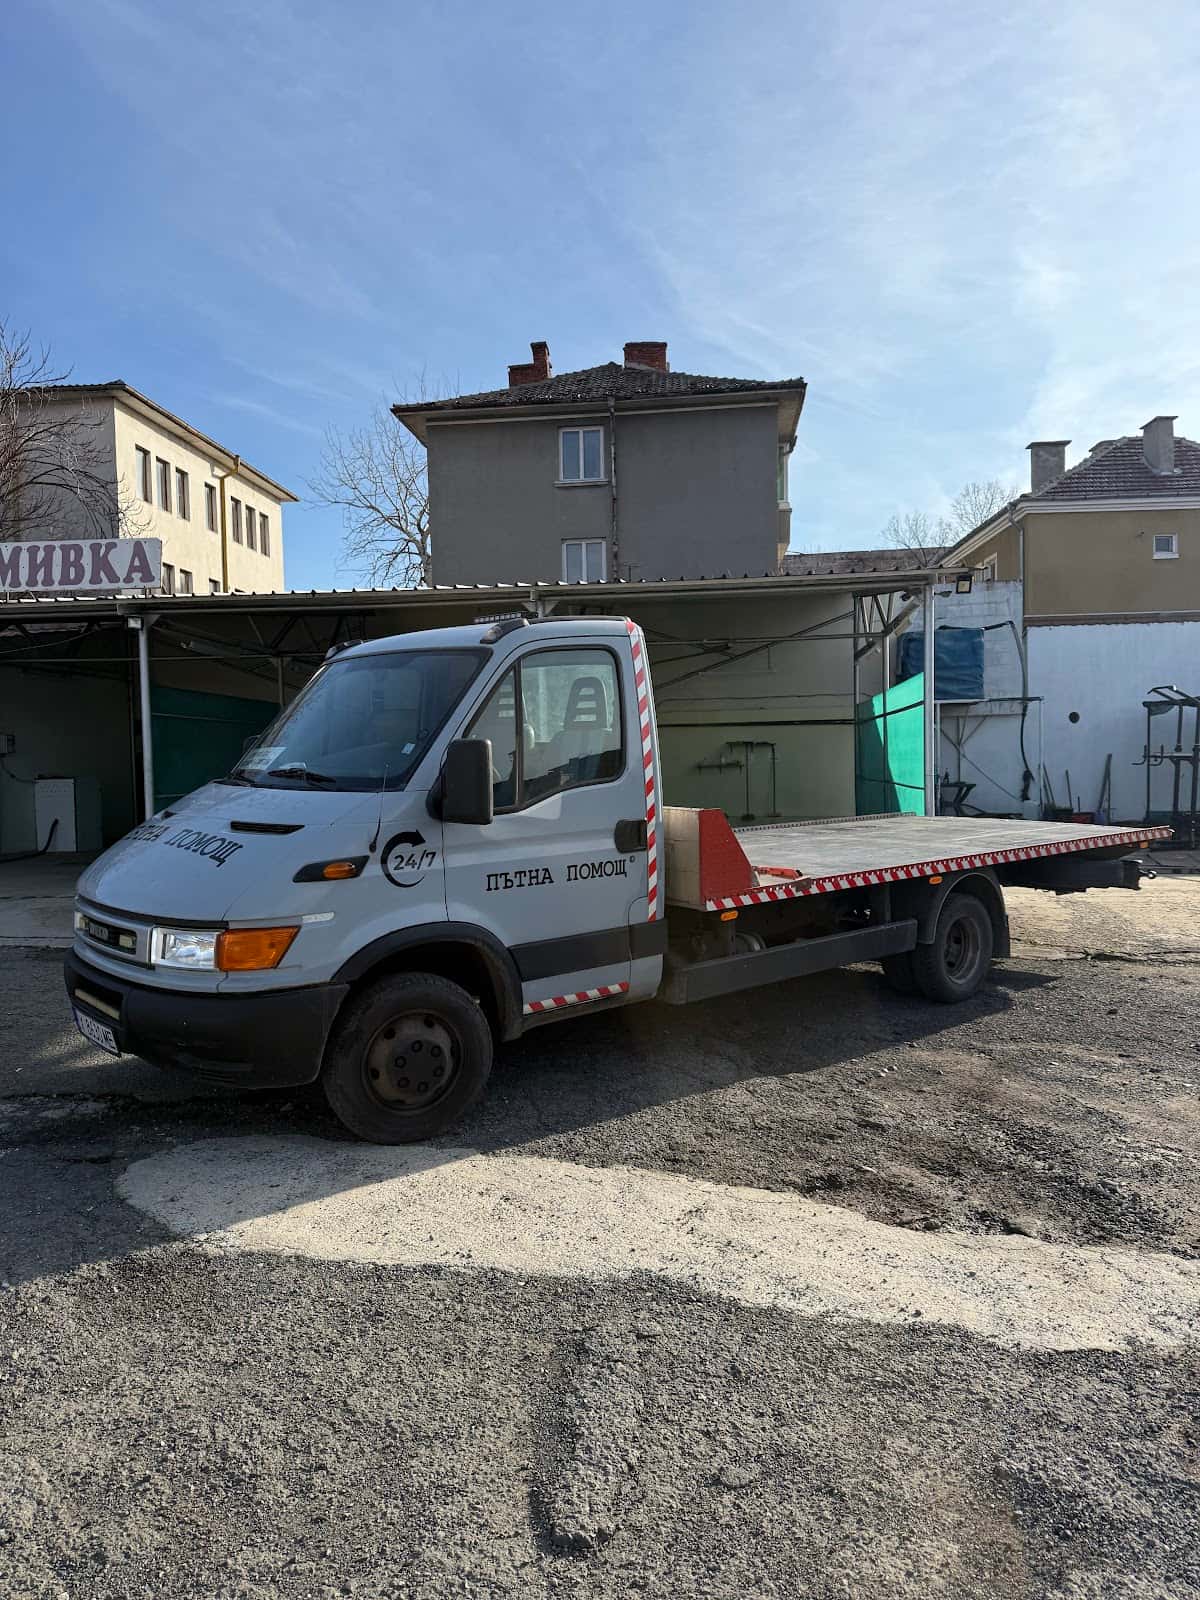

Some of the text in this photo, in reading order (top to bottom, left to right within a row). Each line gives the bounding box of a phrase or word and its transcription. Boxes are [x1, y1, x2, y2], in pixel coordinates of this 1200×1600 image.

[164, 828, 243, 868] ПОМОЩ
[393, 850, 436, 871] 24/7
[486, 860, 627, 891] ПЪТНА ПОМОЩ
